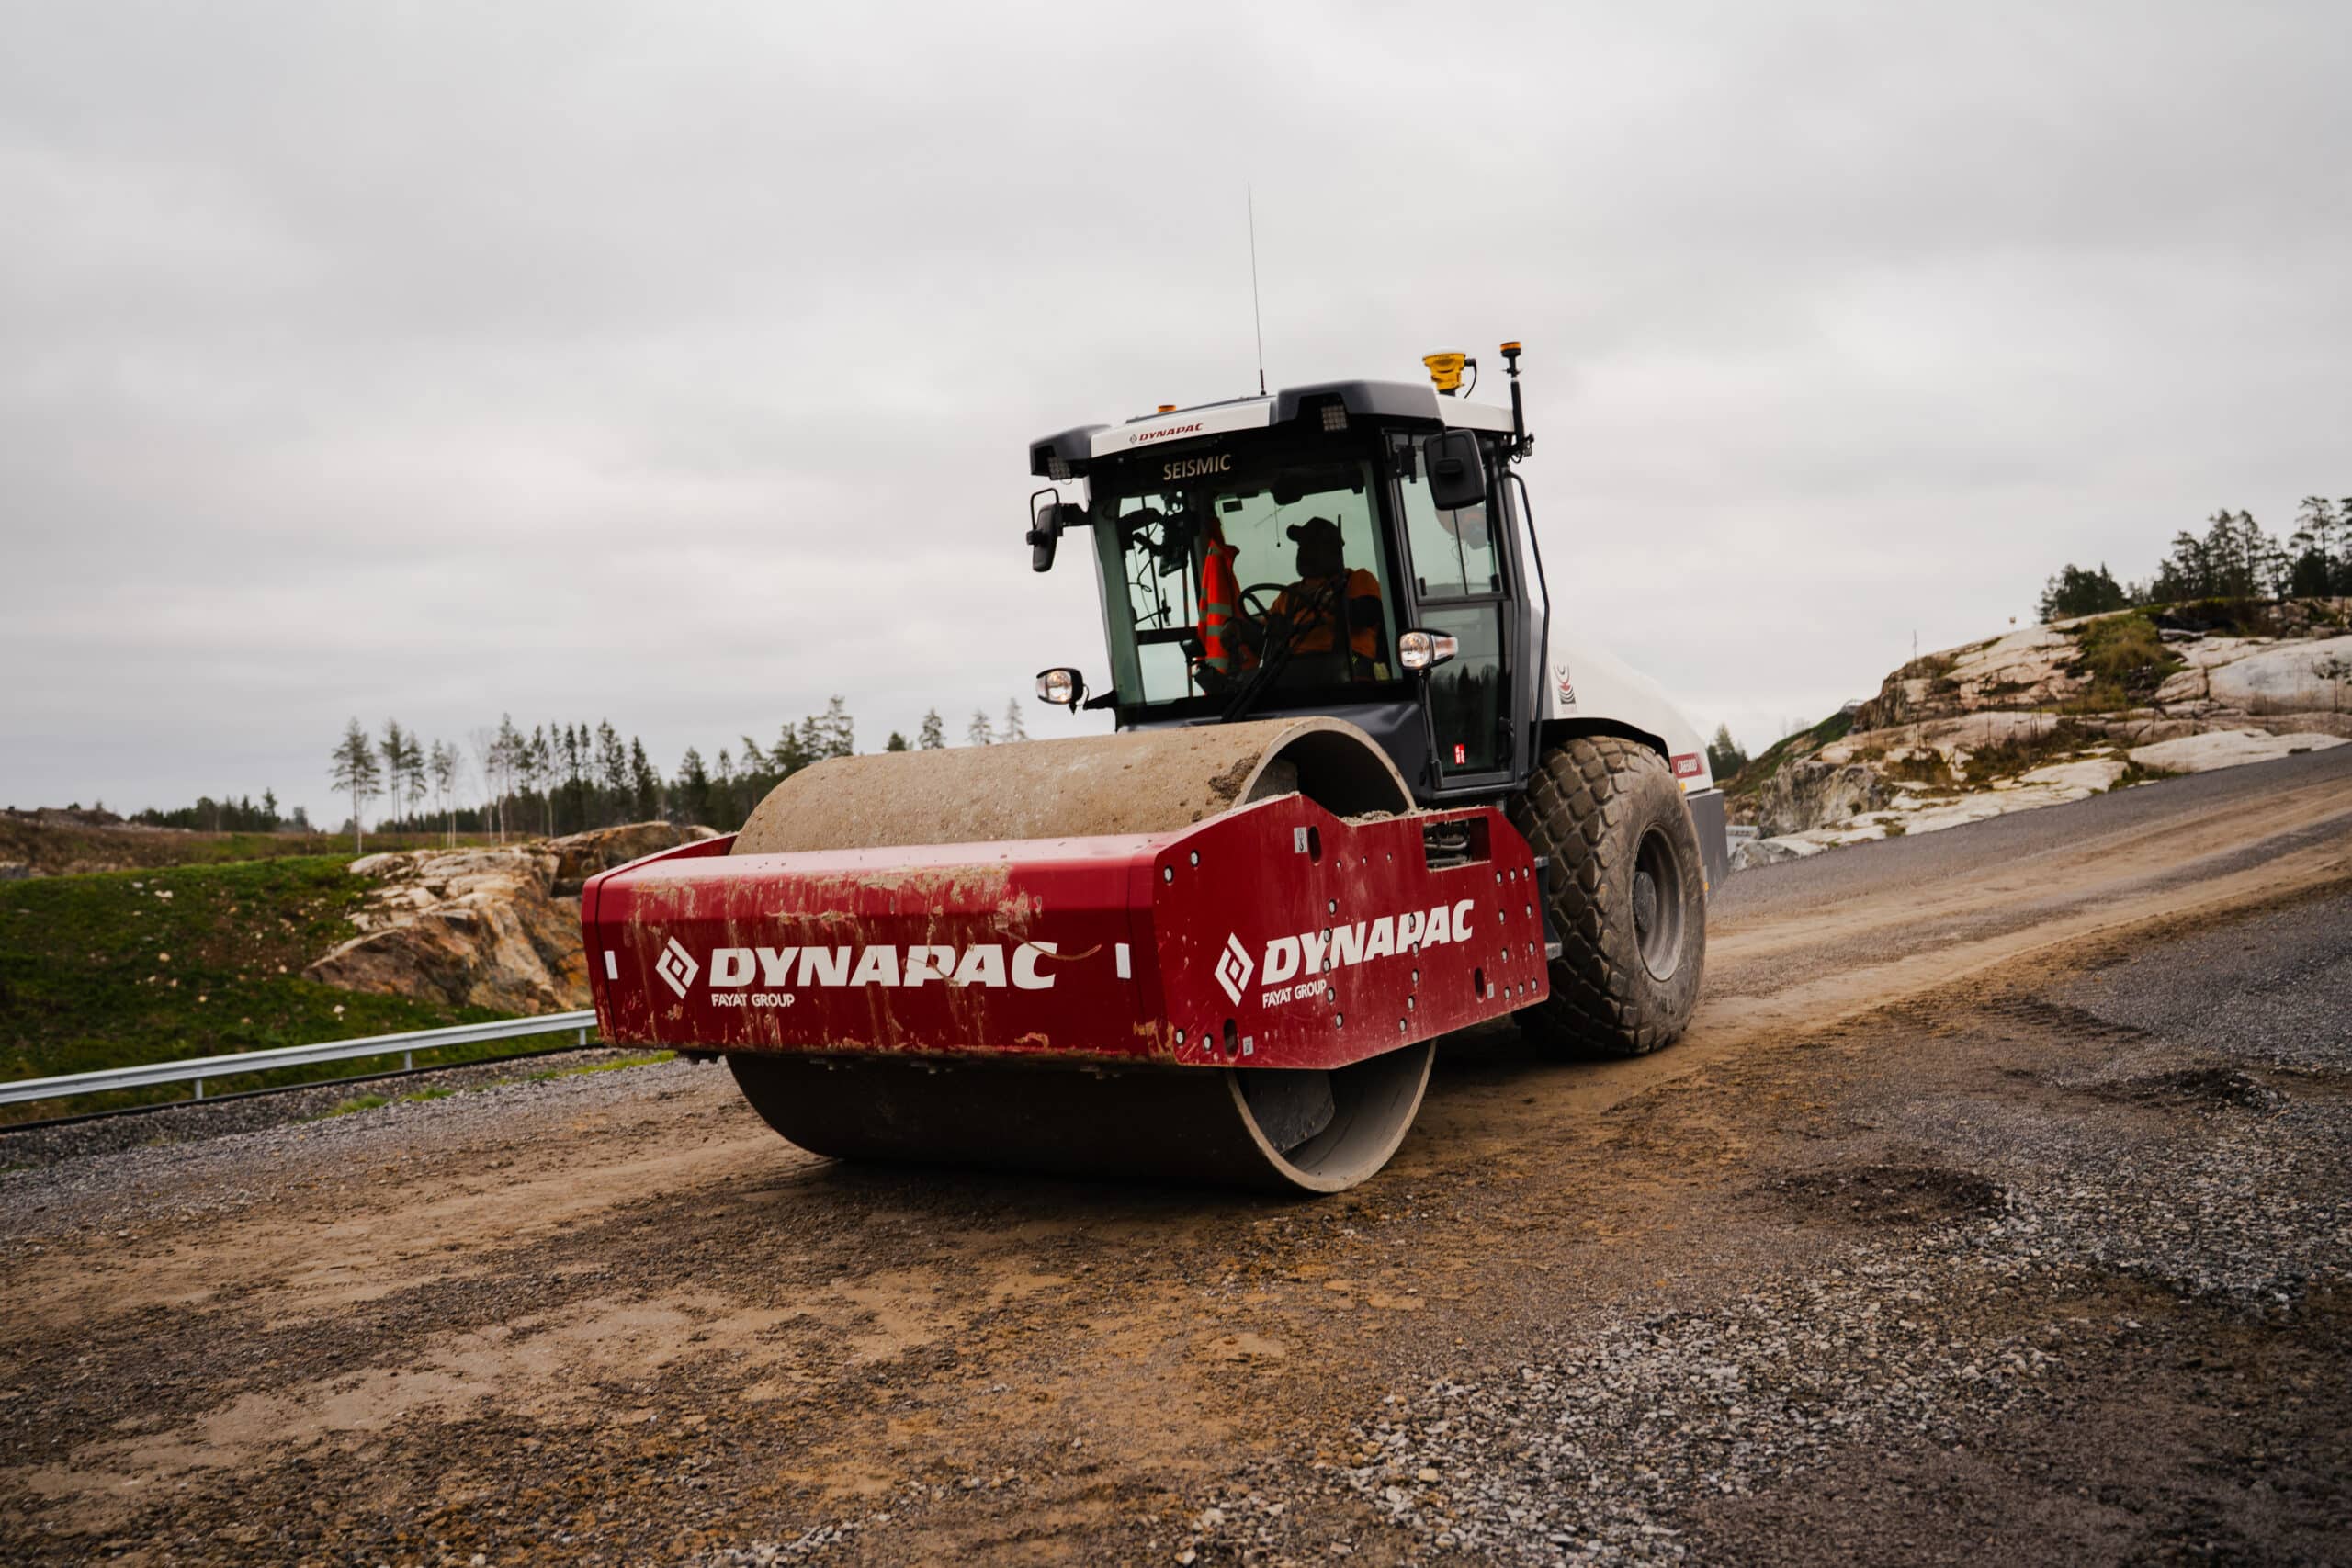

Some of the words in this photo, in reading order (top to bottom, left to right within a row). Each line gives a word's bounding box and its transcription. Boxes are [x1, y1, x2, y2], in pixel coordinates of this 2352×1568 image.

[1139, 423, 1203, 441] DYNAPAC
[1163, 454, 1231, 480] SEISMIC
[1261, 899, 1474, 986] DYNAPAC
[709, 942, 1057, 989] DYNAPAC
[711, 993, 748, 1007] FAYAT
[752, 993, 795, 1008] GROUP
[1261, 987, 1292, 1009] FAYAT
[1295, 979, 1328, 1001] GROUP
